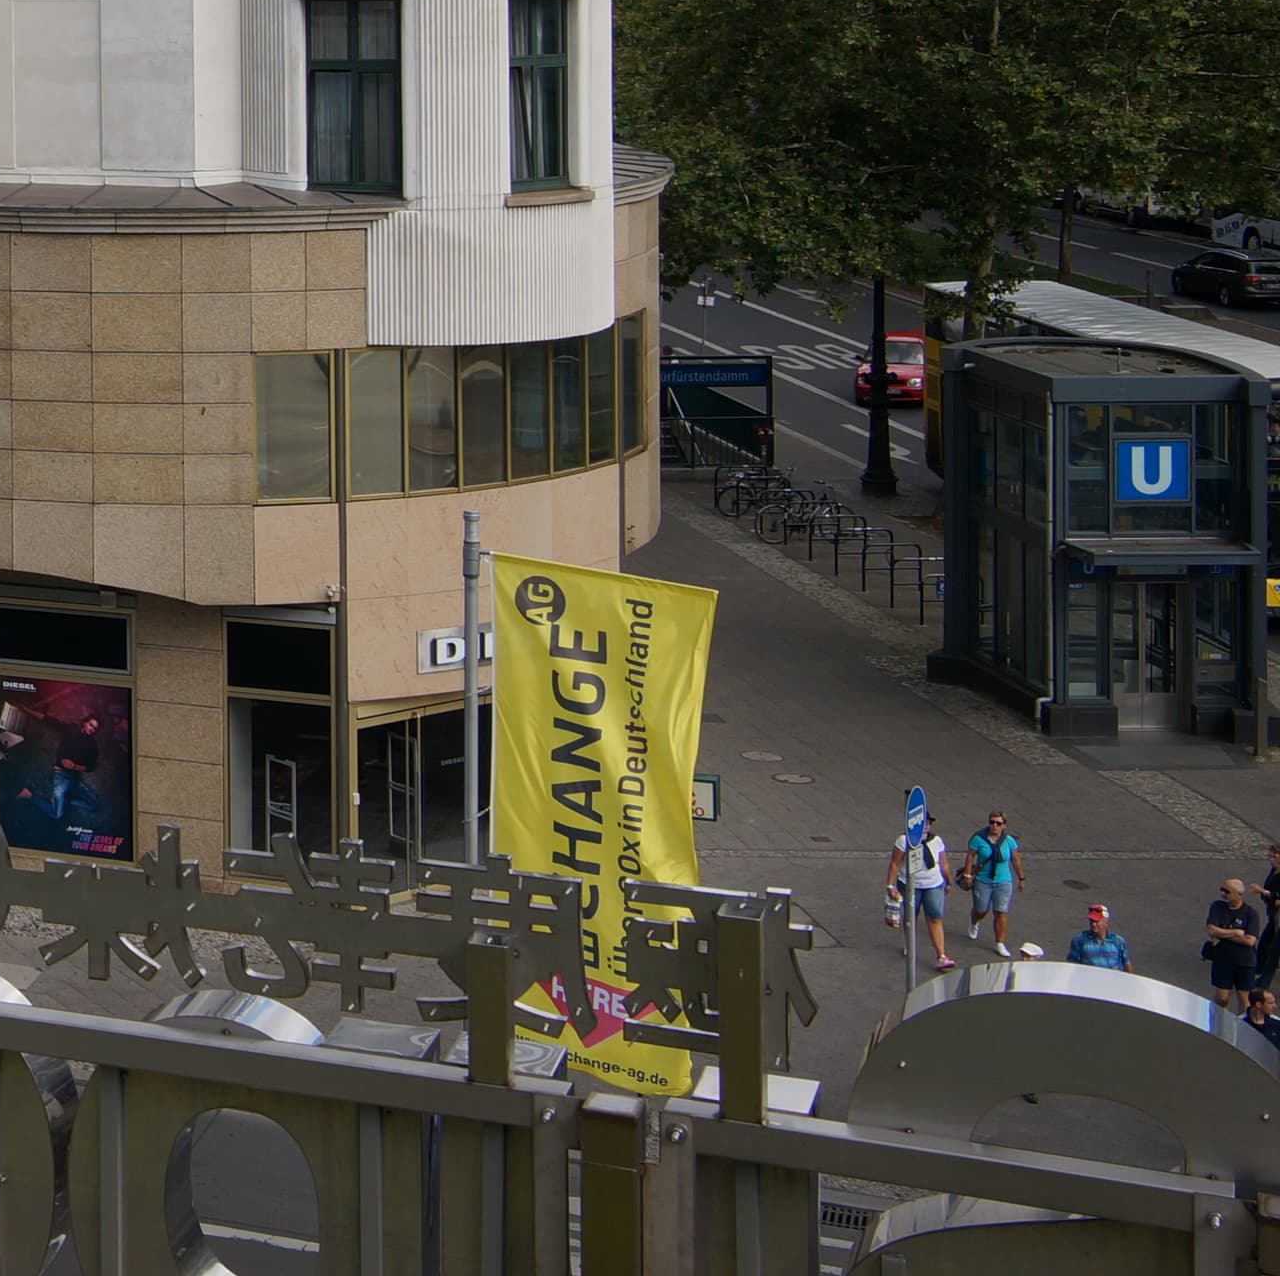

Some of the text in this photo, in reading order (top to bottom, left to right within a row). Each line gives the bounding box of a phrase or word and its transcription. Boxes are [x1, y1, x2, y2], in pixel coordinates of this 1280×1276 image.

[1131, 445, 1173, 495] U
[525, 582, 556, 625] AG
[2, 680, 37, 690] DIESEL
[617, 598, 654, 798] Deutschland
[616, 805, 644, 834] in
